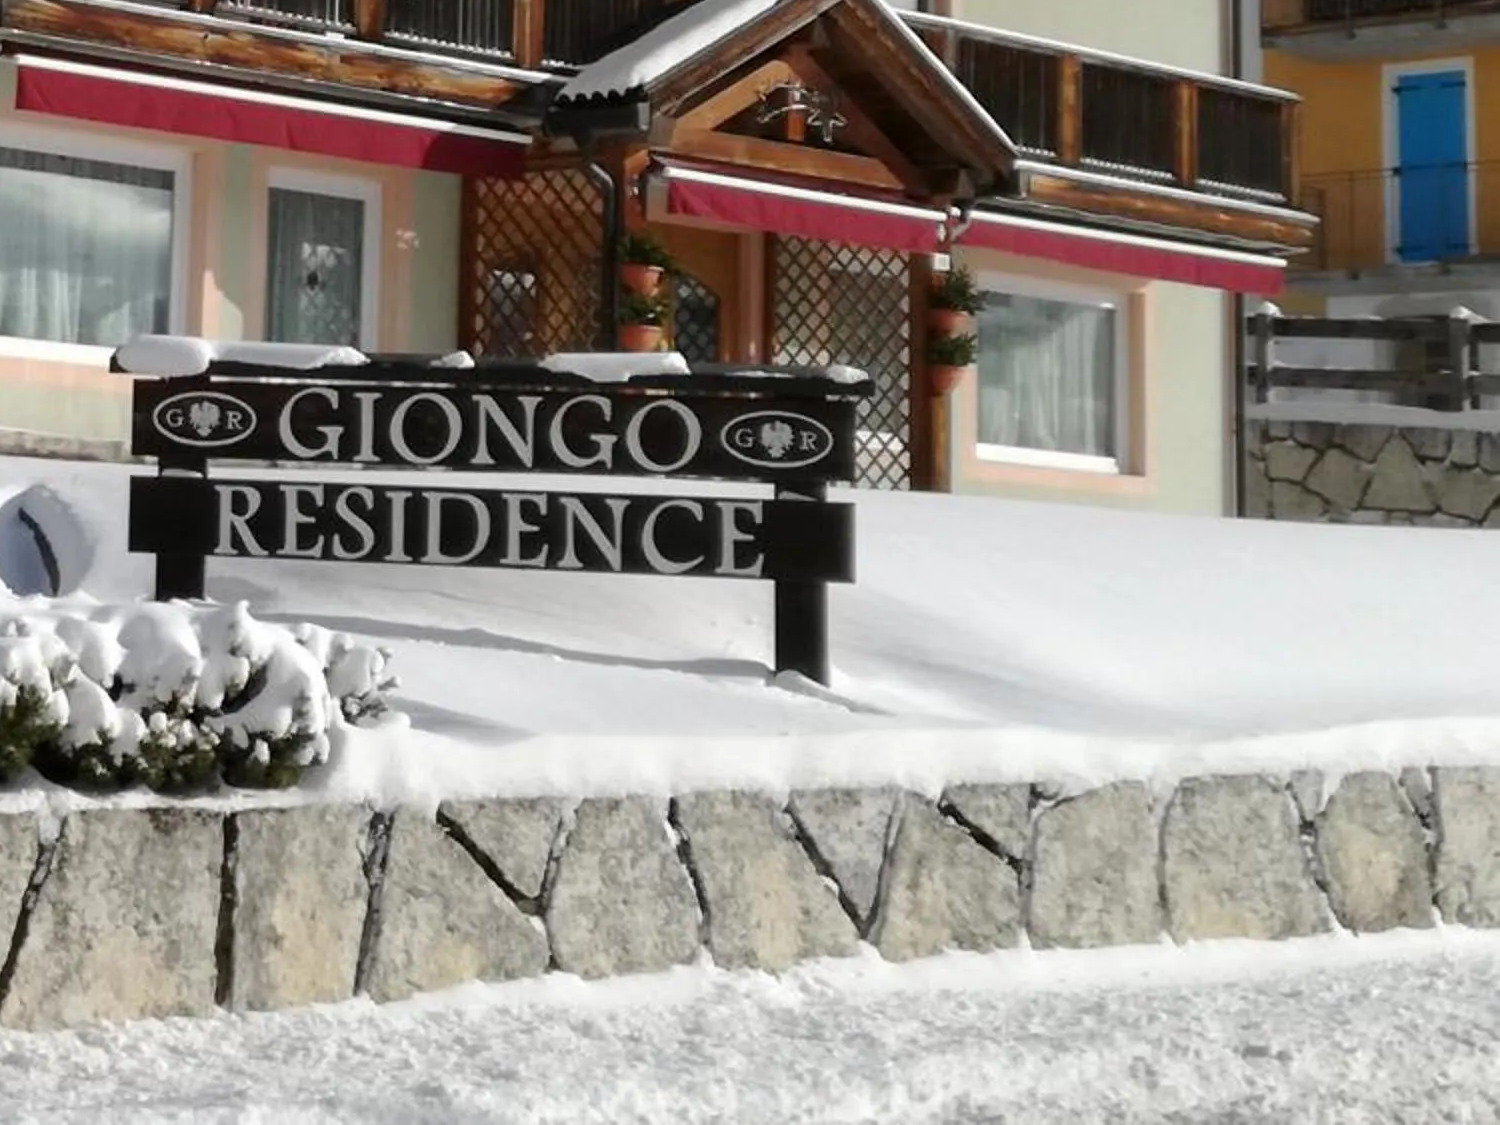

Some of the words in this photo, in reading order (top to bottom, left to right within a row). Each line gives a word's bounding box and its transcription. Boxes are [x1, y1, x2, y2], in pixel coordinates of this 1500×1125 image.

[165, 408, 185, 428] G
[226, 410, 243, 430] R
[278, 387, 702, 473] GIONGO
[735, 428, 755, 448] G
[800, 430, 818, 452] R
[214, 483, 764, 576] RESIDENCE
